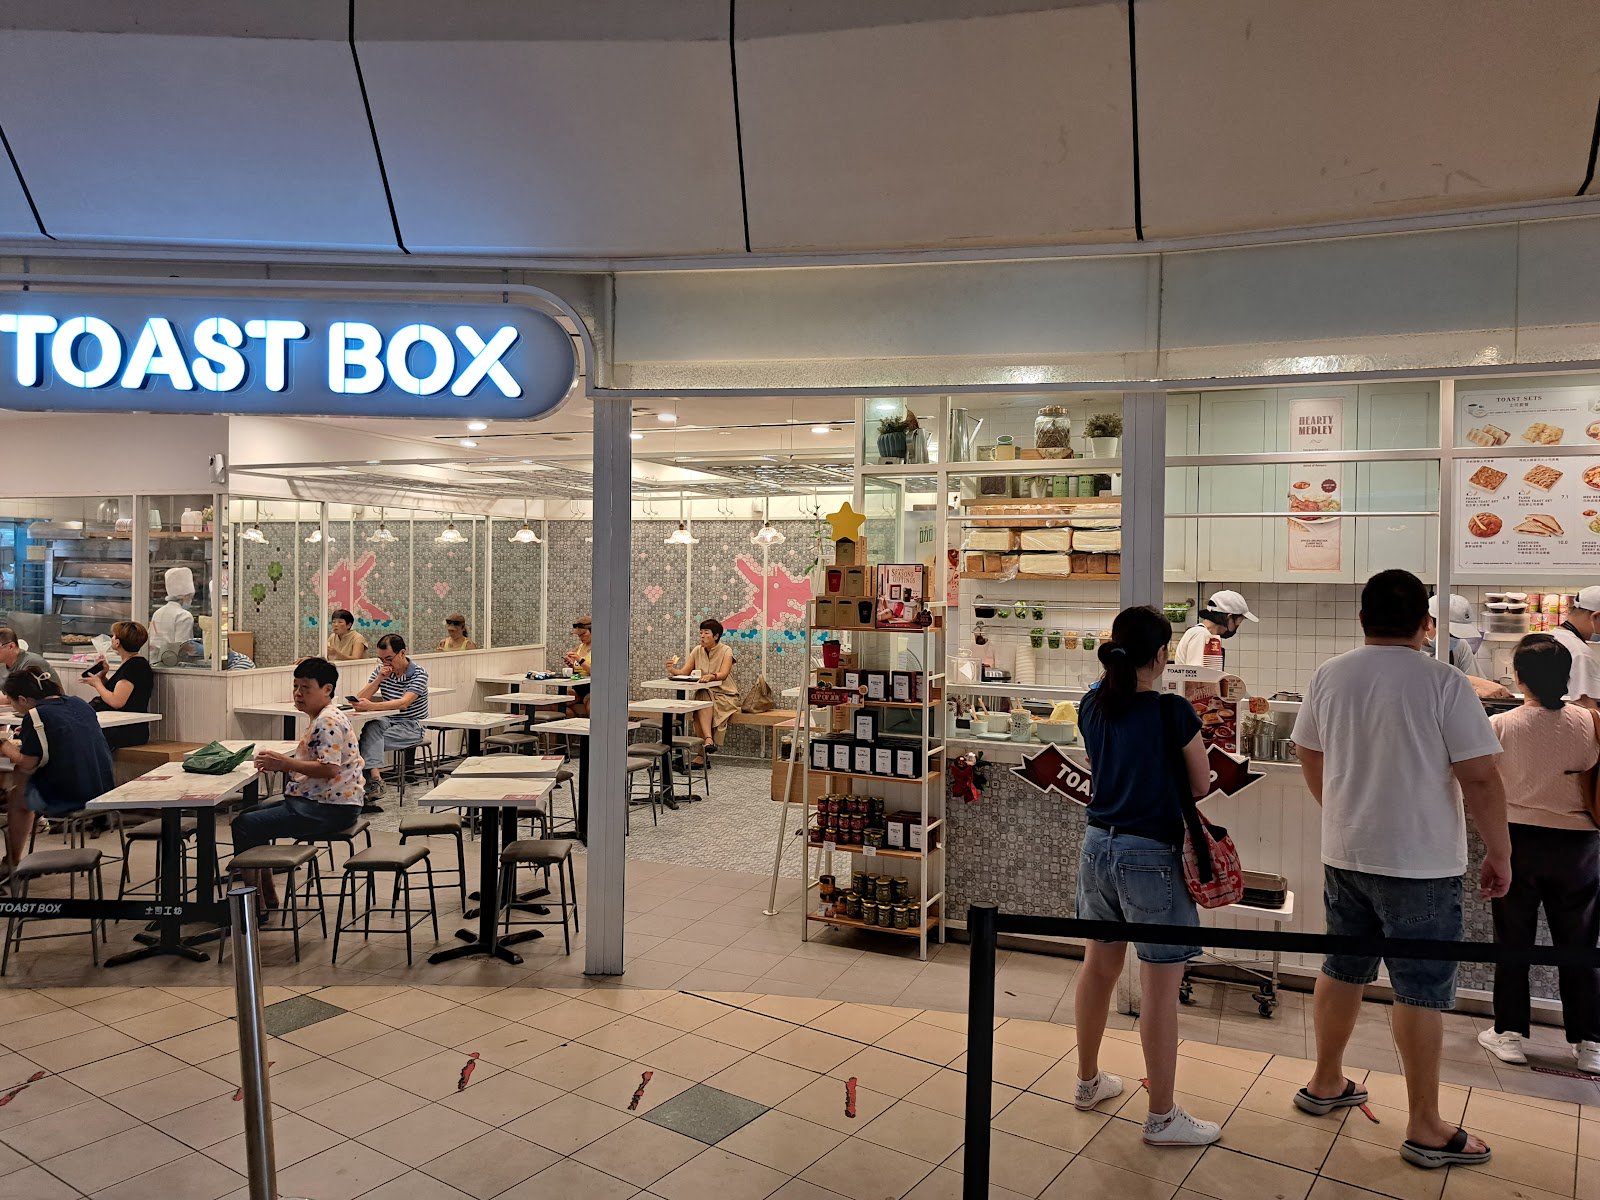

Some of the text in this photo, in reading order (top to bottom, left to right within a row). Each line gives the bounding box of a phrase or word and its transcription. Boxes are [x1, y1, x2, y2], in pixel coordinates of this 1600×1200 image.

[0, 313, 523, 398] TOAST BOX
[1298, 415, 1334, 426] HEARTY
[1298, 425, 1334, 436] MEDLEY
[1056, 763, 1094, 797] TOA
[0, 903, 62, 913] TOAST BOX
